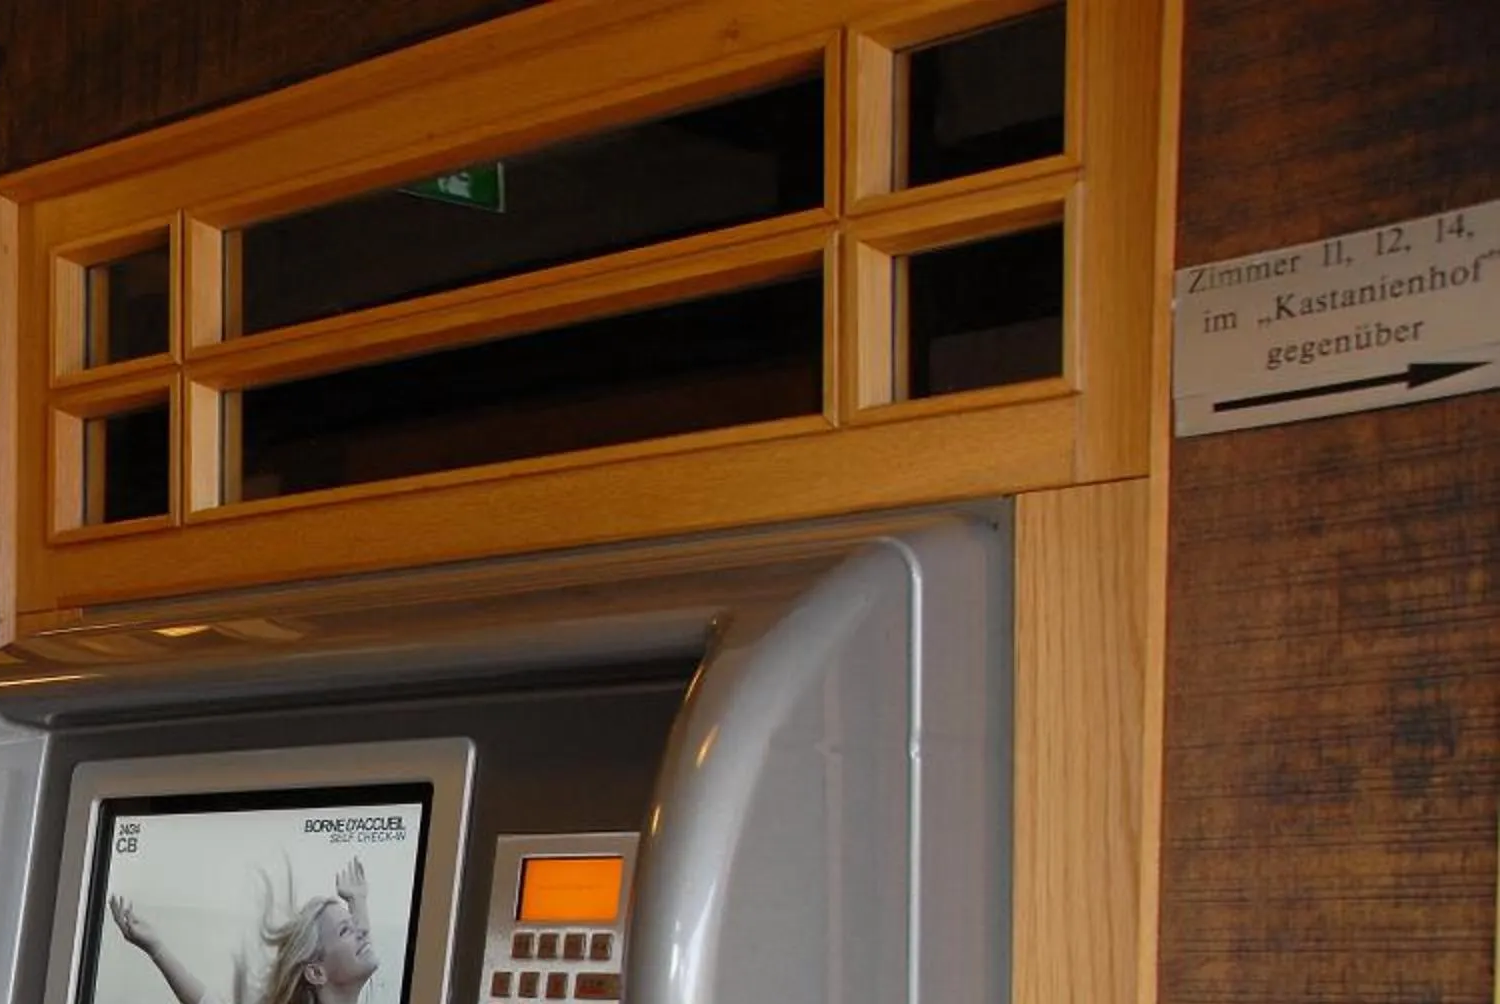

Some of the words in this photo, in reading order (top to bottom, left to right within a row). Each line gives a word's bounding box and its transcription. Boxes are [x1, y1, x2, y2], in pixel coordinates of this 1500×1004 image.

[1188, 254, 1301, 295] Zimmer
[1202, 309, 1238, 334] im
[1266, 319, 1426, 371] gegenüber
[304, 818, 346, 834] BORNE
[115, 837, 138, 854] CB
